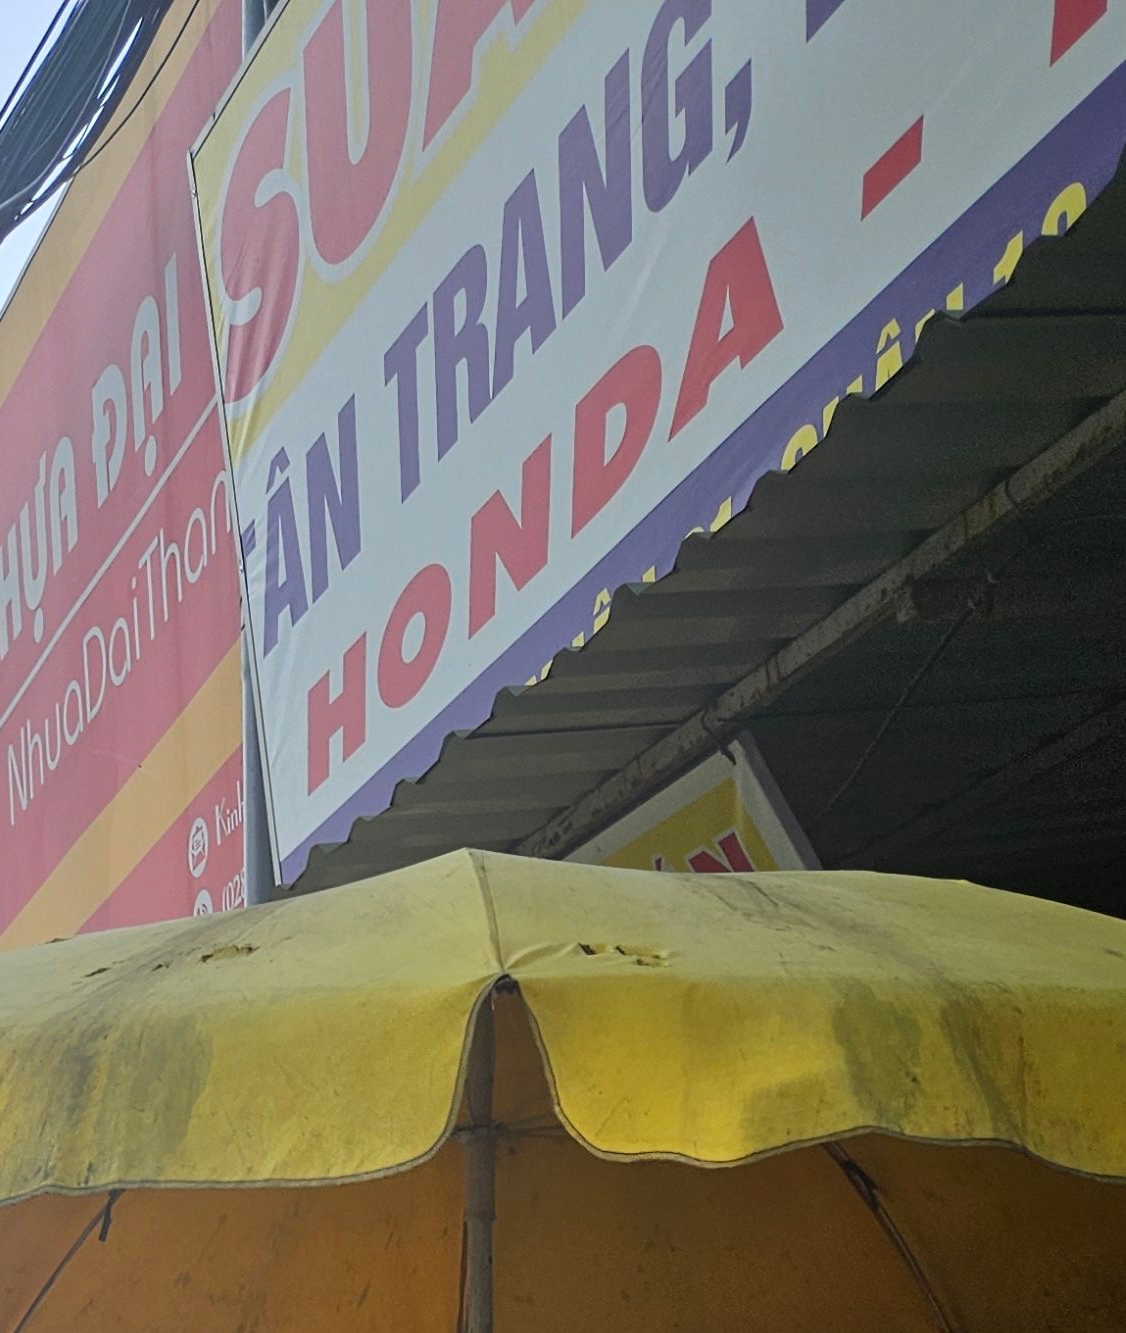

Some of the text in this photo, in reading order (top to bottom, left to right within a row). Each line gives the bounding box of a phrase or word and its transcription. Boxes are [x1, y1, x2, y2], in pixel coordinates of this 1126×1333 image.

[91, 252, 182, 508] ĐẠI
[384, 0, 752, 503] TRANG,
[308, 216, 784, 797] HONDA
